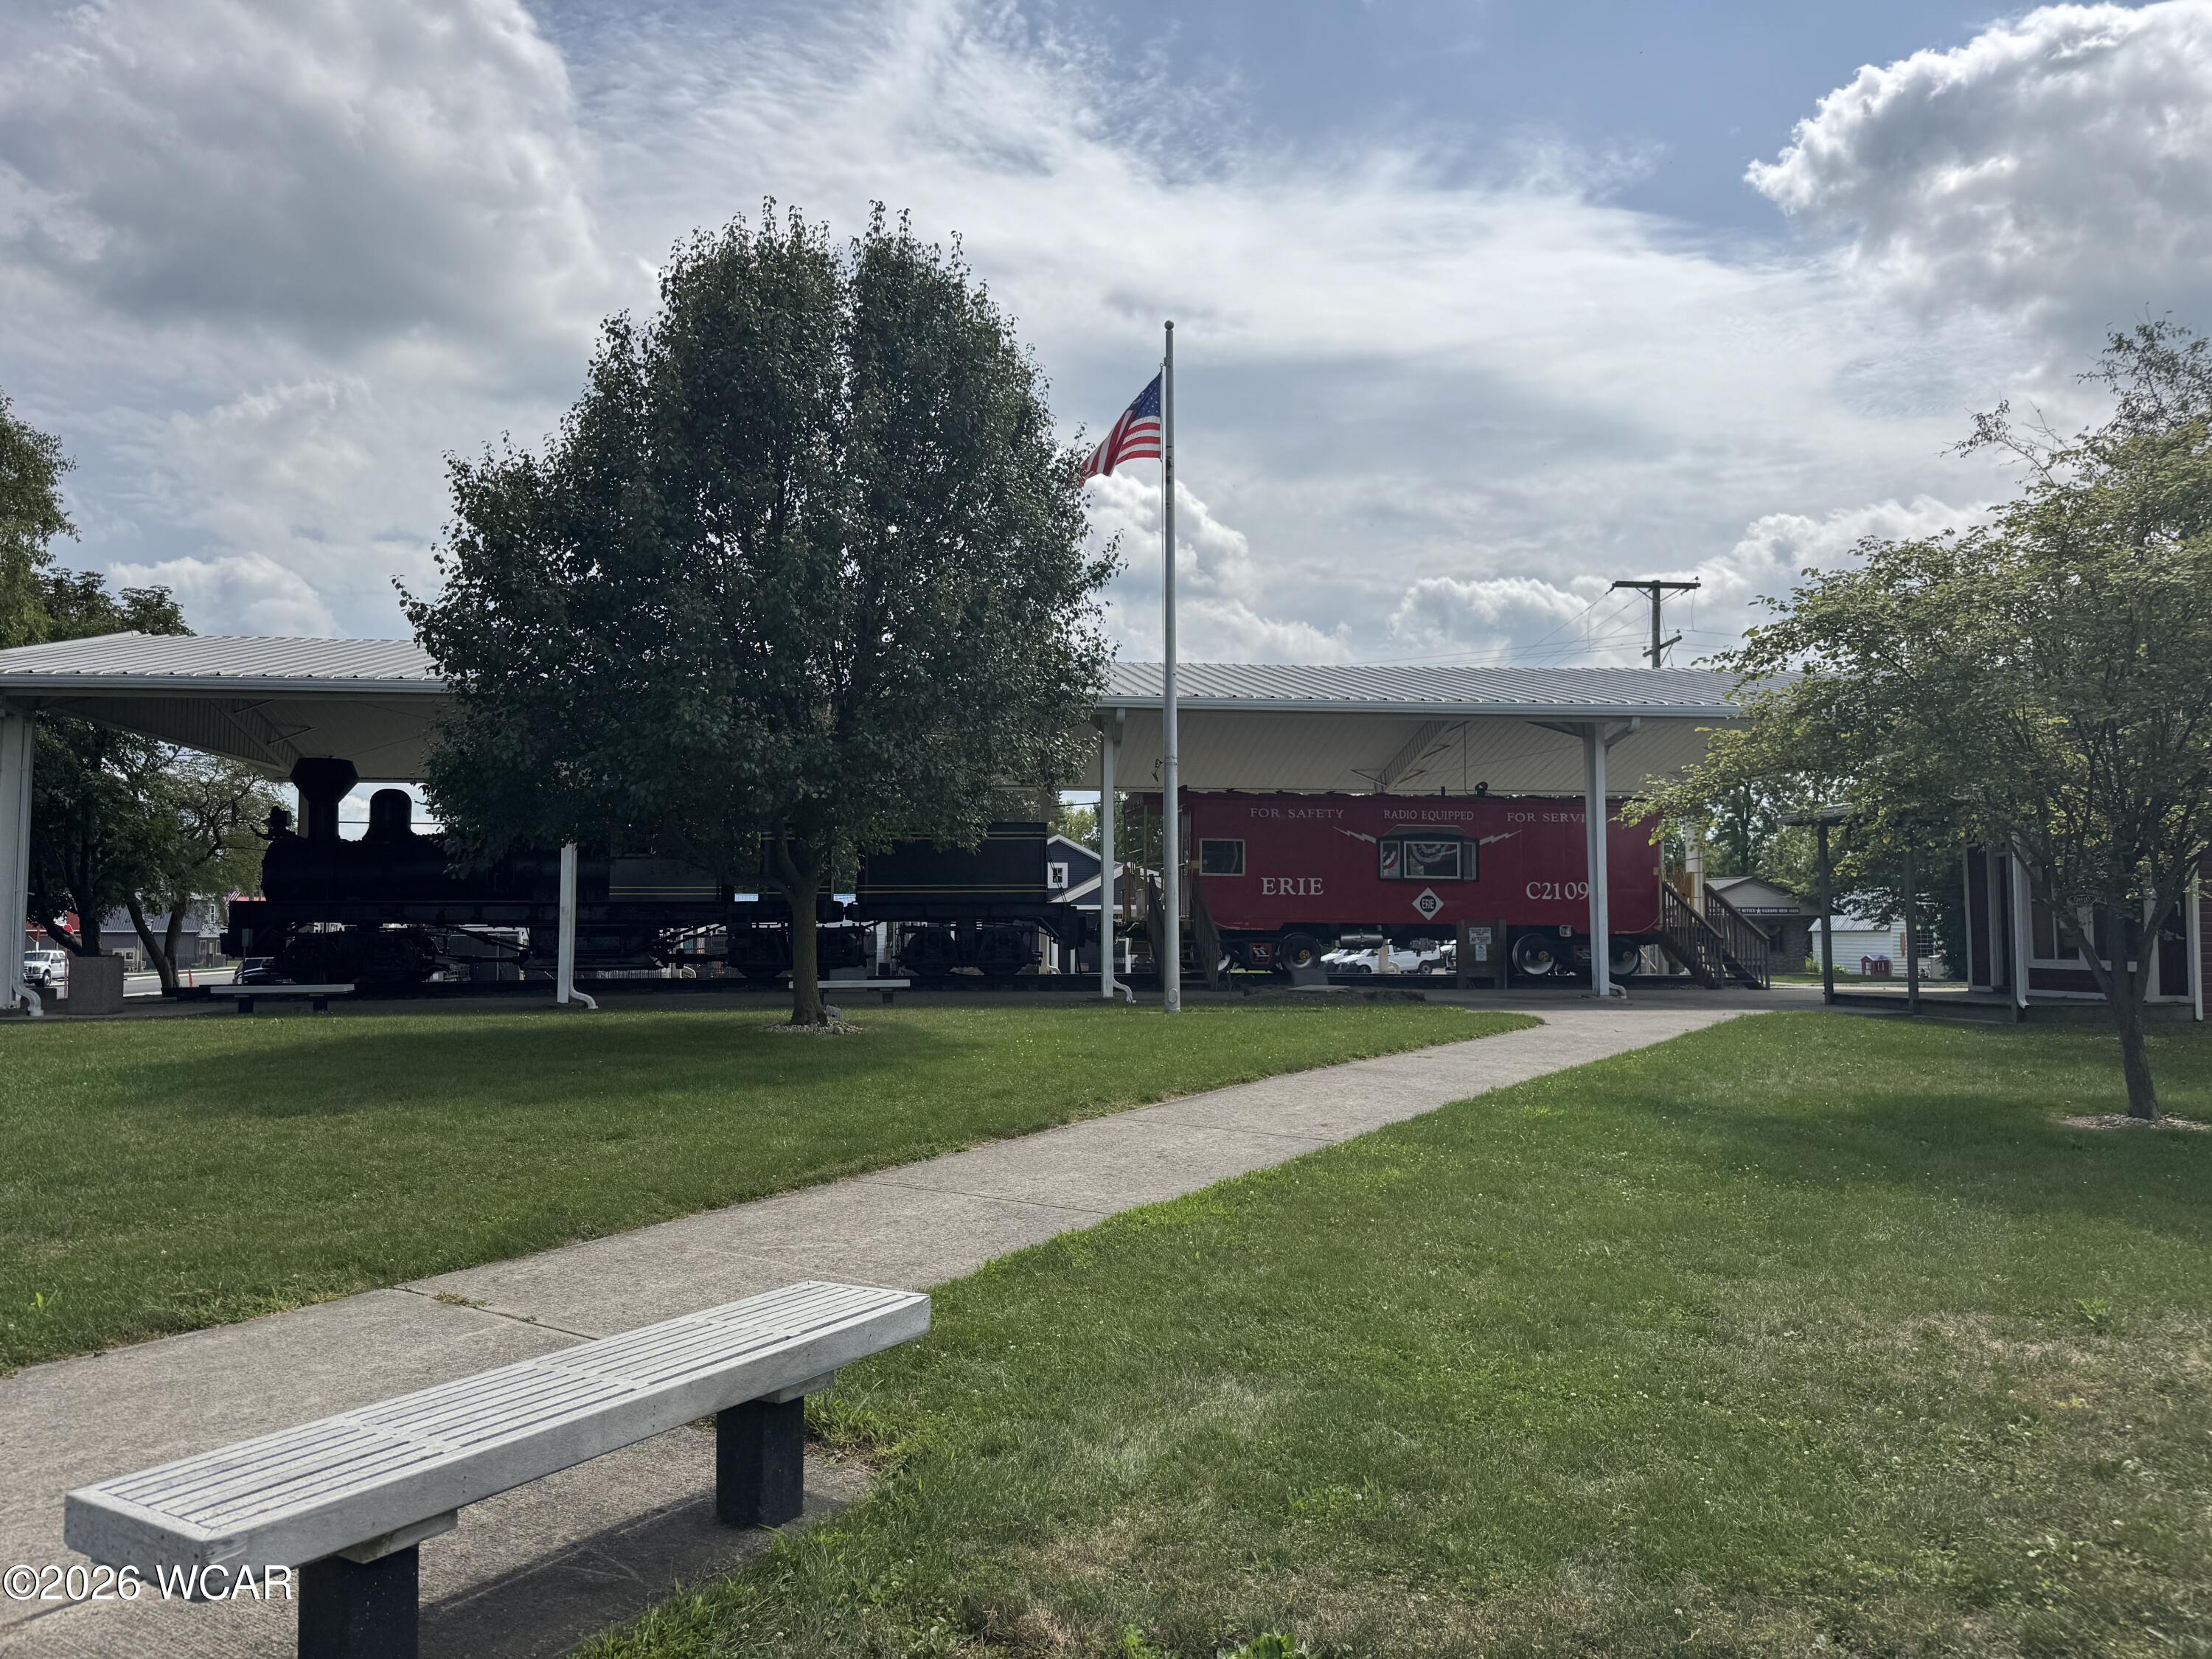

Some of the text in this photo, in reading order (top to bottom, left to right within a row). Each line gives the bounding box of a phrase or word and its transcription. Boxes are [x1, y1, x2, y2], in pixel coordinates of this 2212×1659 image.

[1251, 808, 1343, 818] FOR SAFETY
[1384, 810, 1474, 821] RADIO EQUIPPED
[1507, 813, 1585, 823] FOR SERVI
[1261, 877, 1324, 895] ERIE
[1526, 882, 1589, 900] C2109
[1422, 898, 1435, 909] ERIE
